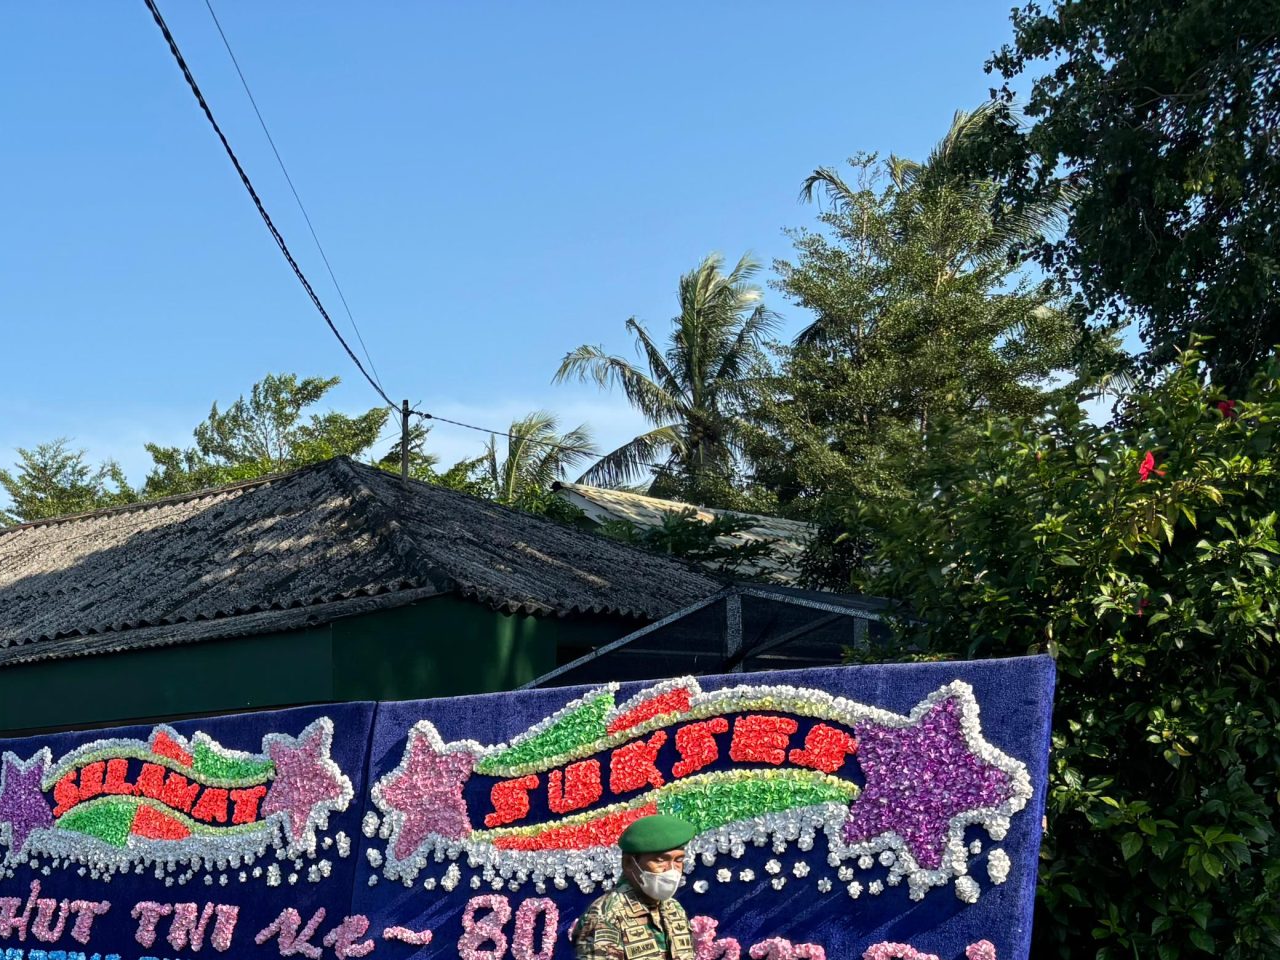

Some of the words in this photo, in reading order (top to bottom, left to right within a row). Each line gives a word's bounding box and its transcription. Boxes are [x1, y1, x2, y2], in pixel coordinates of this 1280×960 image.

[53, 759, 268, 824] SELAMAT
[484, 714, 857, 829] SUKSES
[131, 901, 240, 952] TNI
